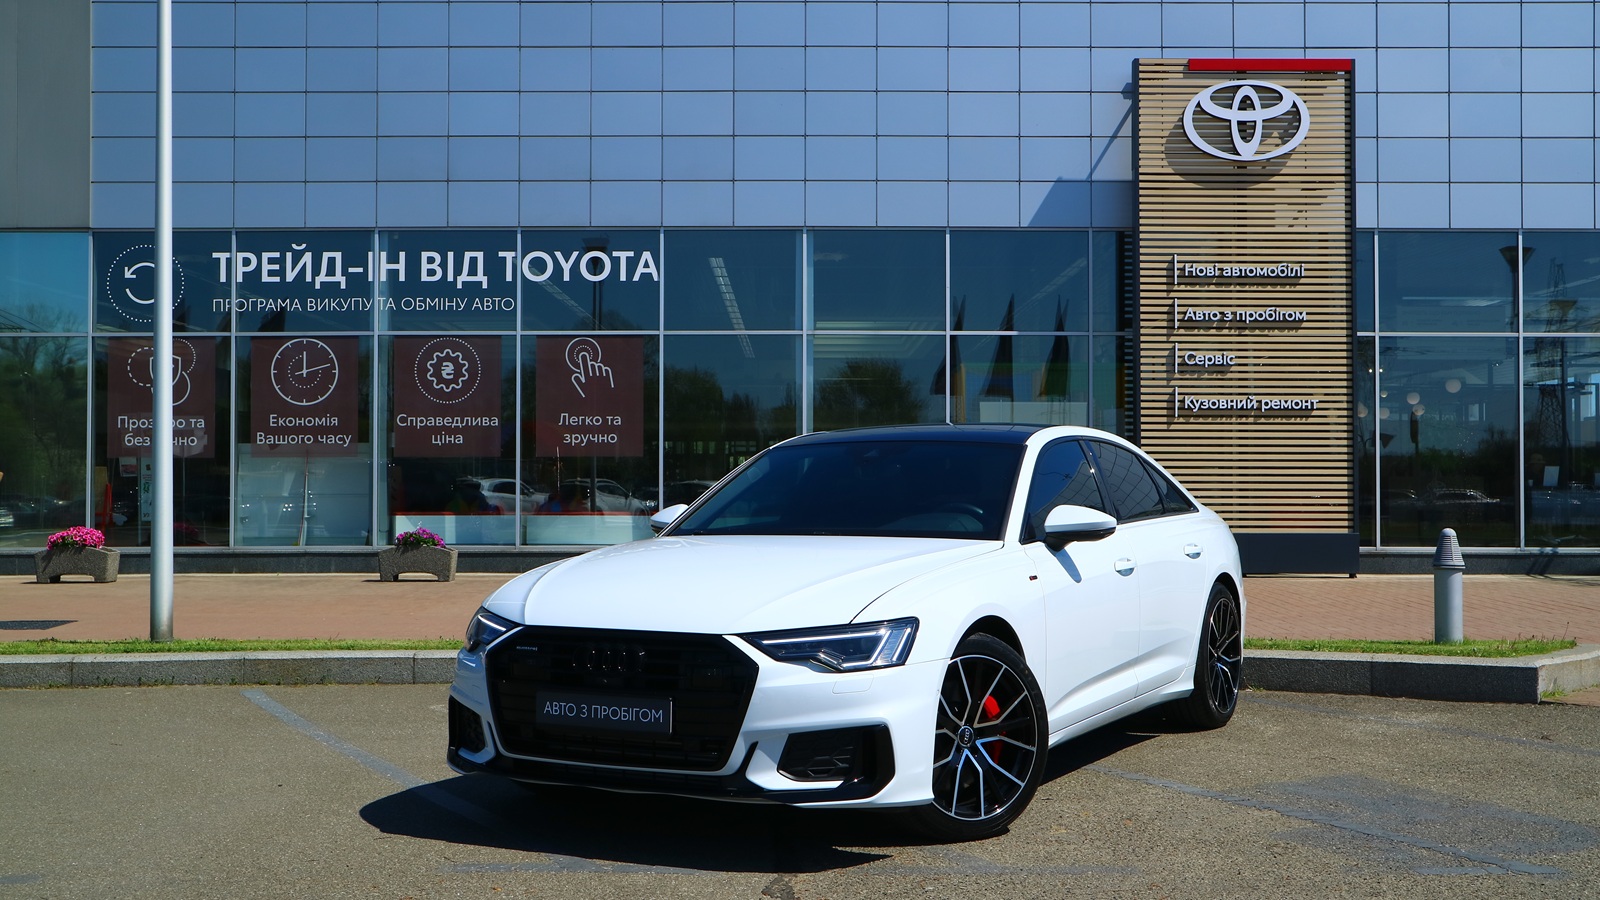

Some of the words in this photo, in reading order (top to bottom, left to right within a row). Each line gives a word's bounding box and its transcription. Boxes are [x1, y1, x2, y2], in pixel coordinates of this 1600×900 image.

[212, 244, 406, 289] ТРЕЙД-ІН
[420, 251, 488, 289] ВІД
[498, 250, 660, 282] TOYOTA
[1184, 262, 1219, 277] Нові
[1222, 262, 1305, 277] автомобілі
[212, 298, 303, 312] ПРОГРАМА
[307, 298, 373, 312] ВИКУПУ
[377, 297, 396, 311] ТА
[401, 297, 468, 311] ОБМІНУ
[471, 297, 515, 311] АВТО
[1184, 308, 1221, 322] Авто
[1223, 309, 1232, 321] з
[1236, 307, 1307, 324] пробігом
[1184, 351, 1236, 367] Сервіс
[1184, 395, 1257, 412] Кузовний
[1261, 397, 1319, 412] ремонт
[189, 418, 205, 428] та
[269, 414, 338, 427] Економія
[396, 413, 499, 429] Справедлива
[558, 413, 603, 426] Легко
[606, 416, 622, 426] та
[256, 432, 314, 445] Вашого
[318, 433, 352, 446] часу
[431, 431, 464, 445] ціна
[563, 431, 618, 446] зручно
[543, 701, 577, 717] АВТО
[580, 704, 588, 718] З
[591, 705, 663, 723] ПРОБІГОМ
